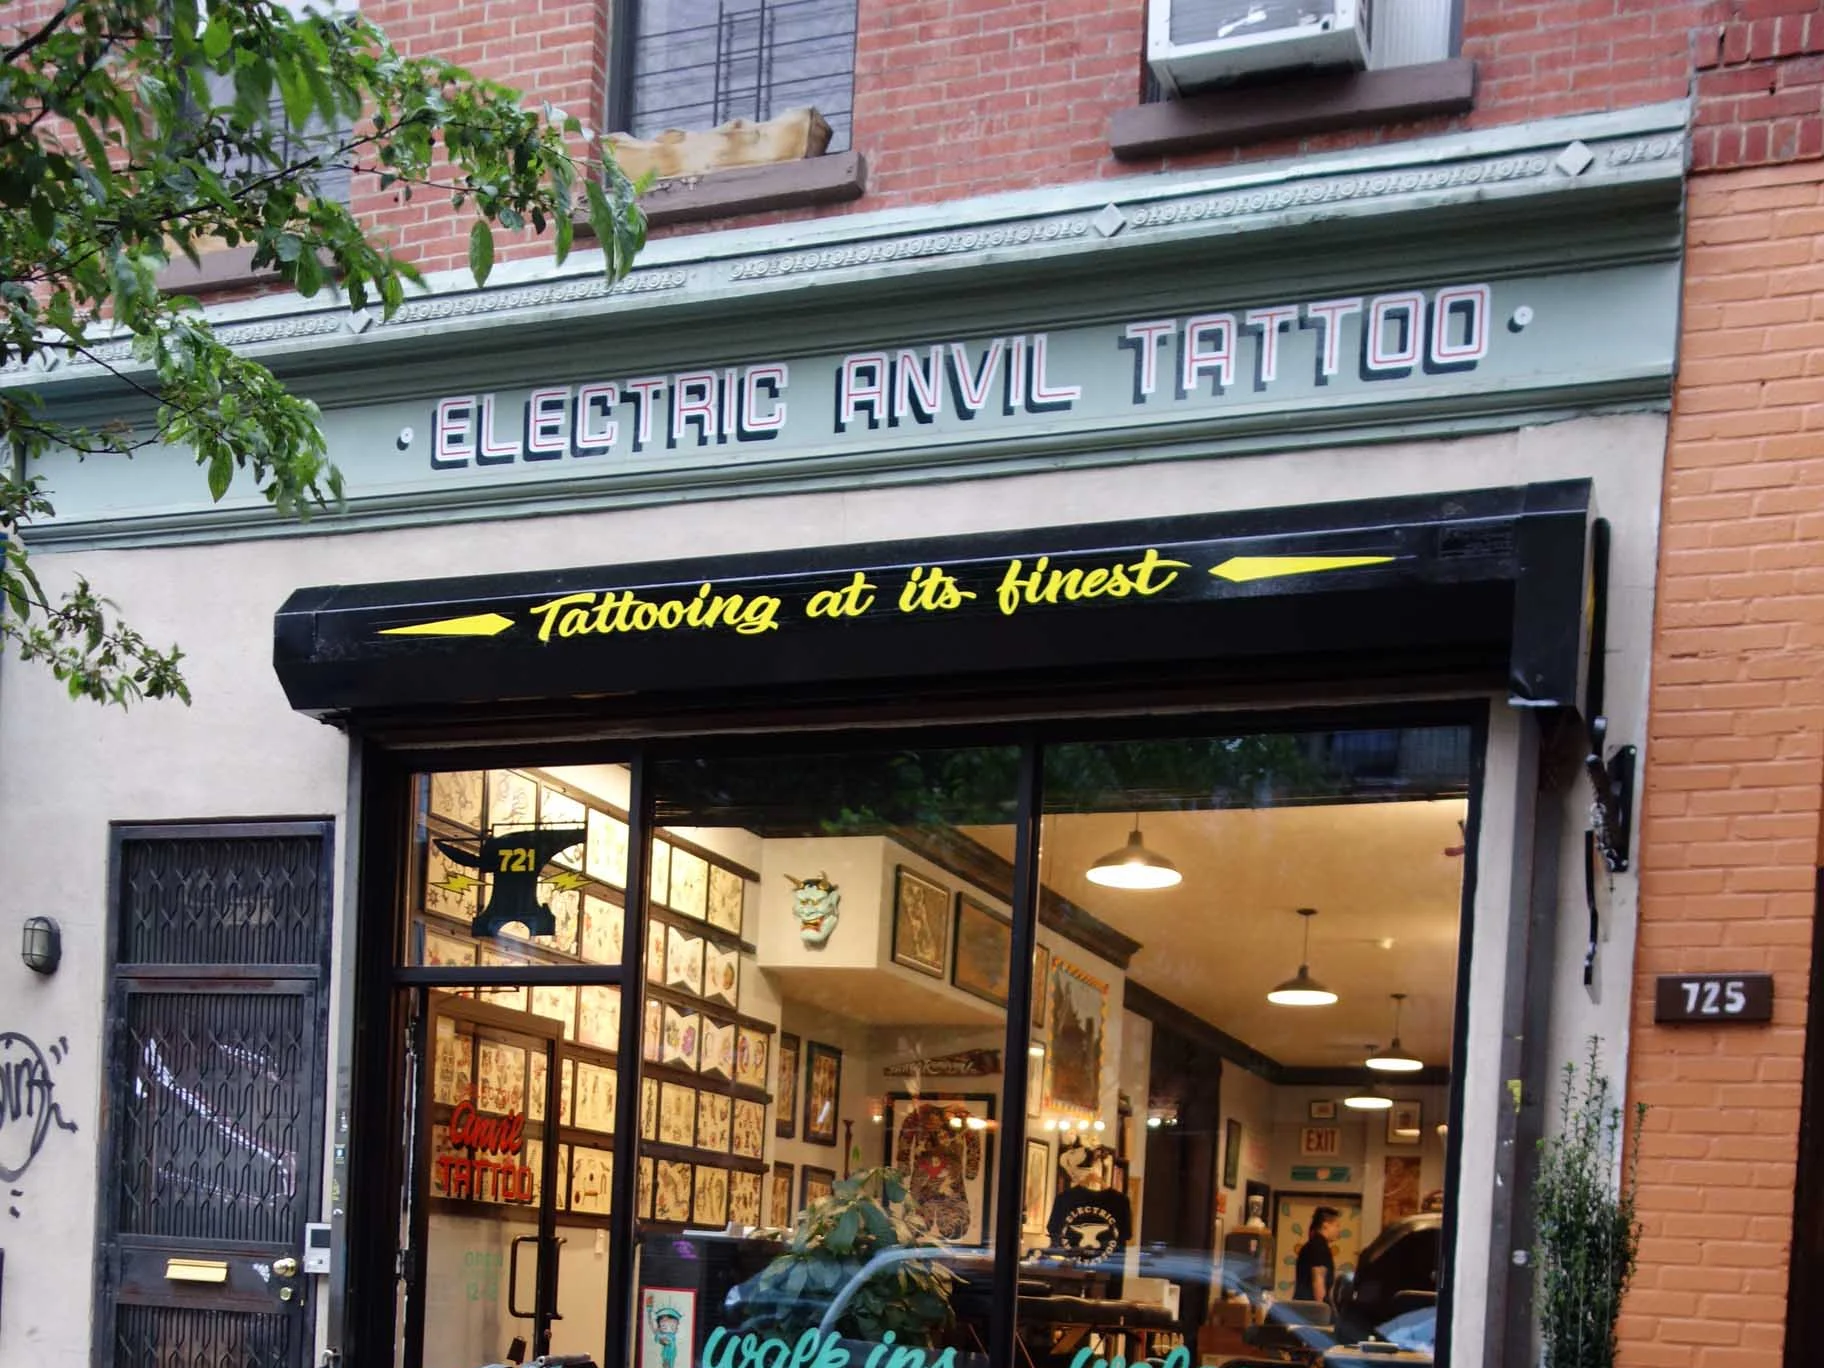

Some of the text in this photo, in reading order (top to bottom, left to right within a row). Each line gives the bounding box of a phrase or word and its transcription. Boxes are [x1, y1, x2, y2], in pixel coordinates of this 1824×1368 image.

[431, 283, 1491, 469] ELECTRIC ANVIL TATTOO
[529, 549, 1192, 643] Tattooing at its finest
[498, 848, 536, 873] 721
[1681, 981, 1746, 1014] 725
[1306, 1129, 1336, 1153] EXIT
[435, 1154, 533, 1204] TATTOO
[1065, 1205, 1117, 1225] ELECTRIC
